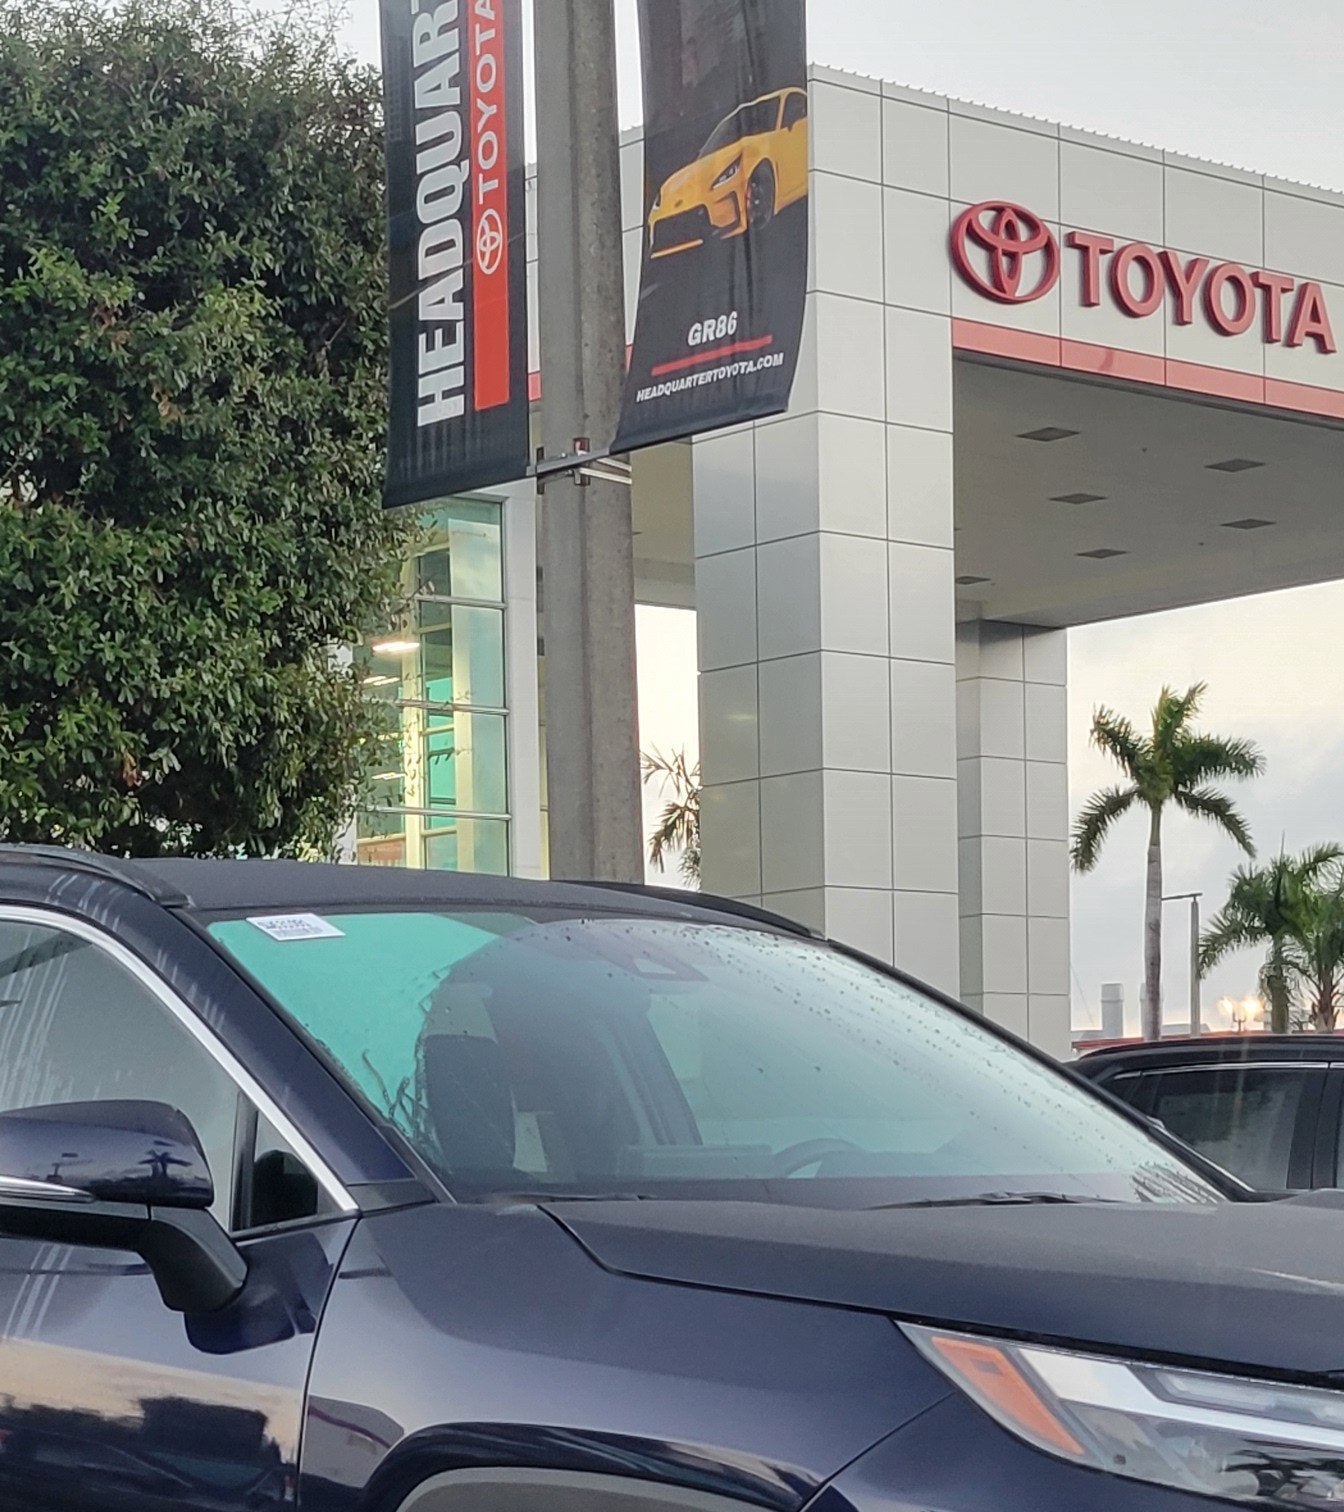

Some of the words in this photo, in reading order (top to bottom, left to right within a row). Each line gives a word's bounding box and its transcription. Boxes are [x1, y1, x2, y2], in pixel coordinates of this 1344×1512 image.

[411, 0, 470, 427] HEADQUAR
[687, 311, 738, 346] GR86
[1068, 231, 1336, 354] TOYOTA
[636, 353, 784, 402] HEADQUARTERTOYOTA.COM
